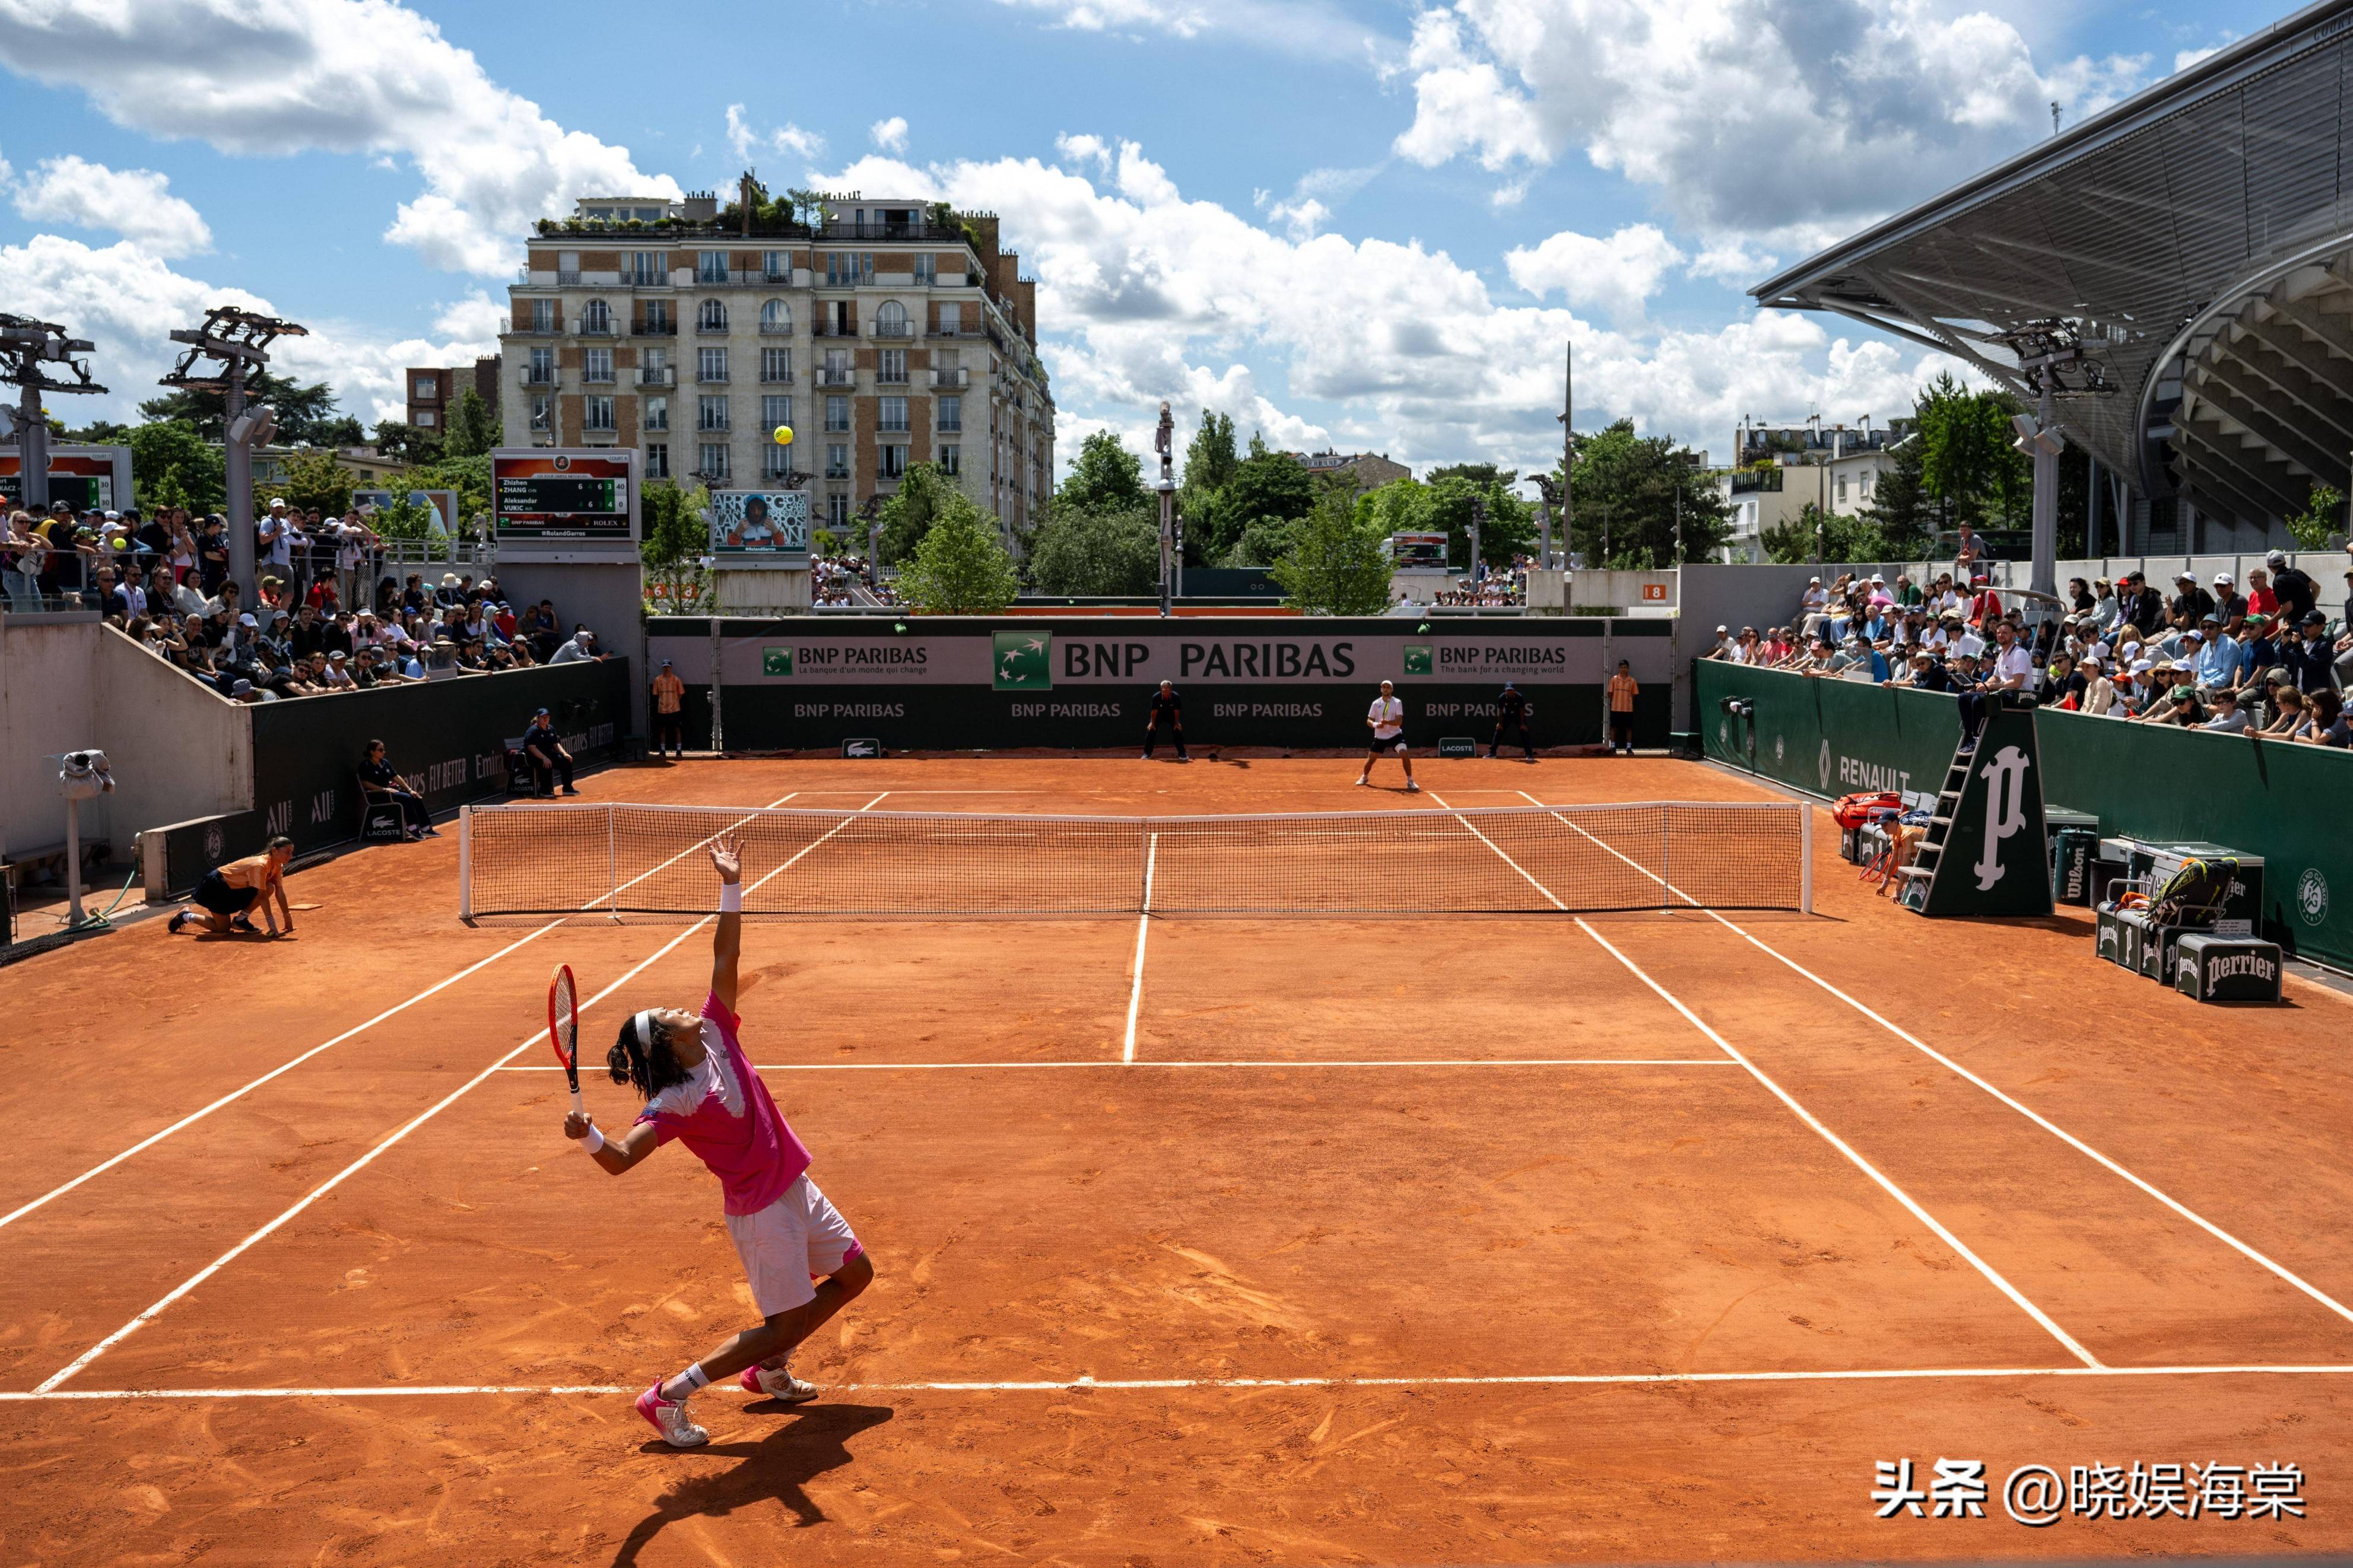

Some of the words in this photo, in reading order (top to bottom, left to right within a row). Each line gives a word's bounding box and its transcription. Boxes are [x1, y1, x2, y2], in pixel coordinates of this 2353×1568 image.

[654, 586, 662, 596] 6
[1653, 587, 1660, 598] 8
[799, 648, 839, 664] BNP
[845, 647, 927, 664] PARIBAS
[1065, 643, 1149, 677] BNP
[1180, 643, 1355, 677] PARIBAS
[1440, 647, 1479, 663] BNP
[1485, 647, 1565, 663] PARIBAS
[810, 667, 837, 675] banque
[887, 666, 898, 675] qui
[900, 666, 927, 675] change
[1479, 666, 1492, 675] for
[1502, 666, 1538, 675] changing
[795, 704, 829, 717] BNP
[834, 704, 904, 717] PARIBAS
[1011, 704, 1047, 717] BNP
[1050, 704, 1120, 717] PARIBAS
[1214, 704, 1249, 717] BNP
[1253, 704, 1323, 717] PARIBAS
[1426, 704, 1459, 717] BNP
[557, 731, 588, 753] mirates
[476, 750, 504, 780] Emira
[1840, 755, 1910, 793] RENAULT
[429, 763, 442, 793] FLY
[443, 758, 466, 788] BETTER
[2068, 845, 2085, 898] Wilson
[2298, 872, 2313, 900] ROLAND
[2314, 873, 2327, 907] GARROS
[2142, 942, 2161, 968] perrie
[2178, 956, 2199, 982] perrier
[2206, 950, 2275, 997] perrier
